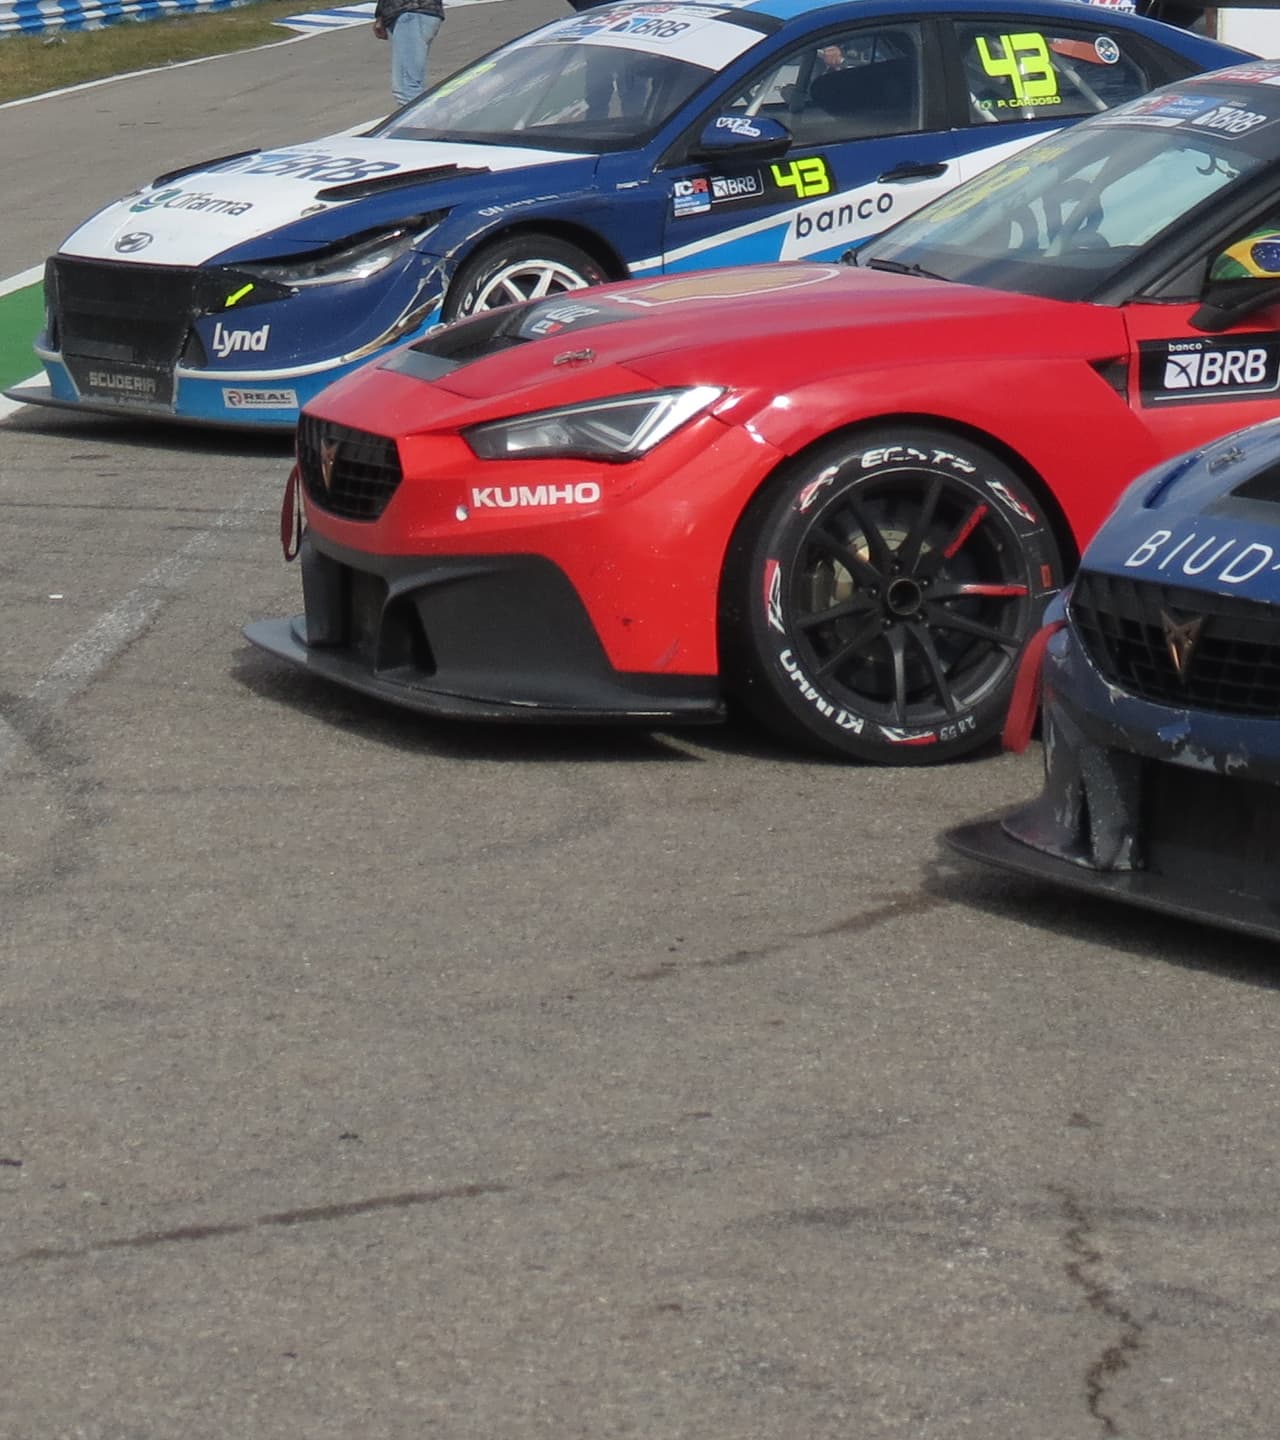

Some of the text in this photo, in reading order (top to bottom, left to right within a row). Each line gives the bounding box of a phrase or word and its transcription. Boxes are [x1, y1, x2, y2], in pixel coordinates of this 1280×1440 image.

[975, 32, 1058, 100] 43
[727, 175, 757, 195] BRB
[770, 157, 831, 199] 43
[795, 192, 894, 241] banco
[212, 322, 270, 358] Lynd
[1168, 342, 1203, 352] banco
[1200, 349, 1268, 387] BRB
[244, 393, 289, 402] REAL
[472, 482, 601, 508] KUMHO
